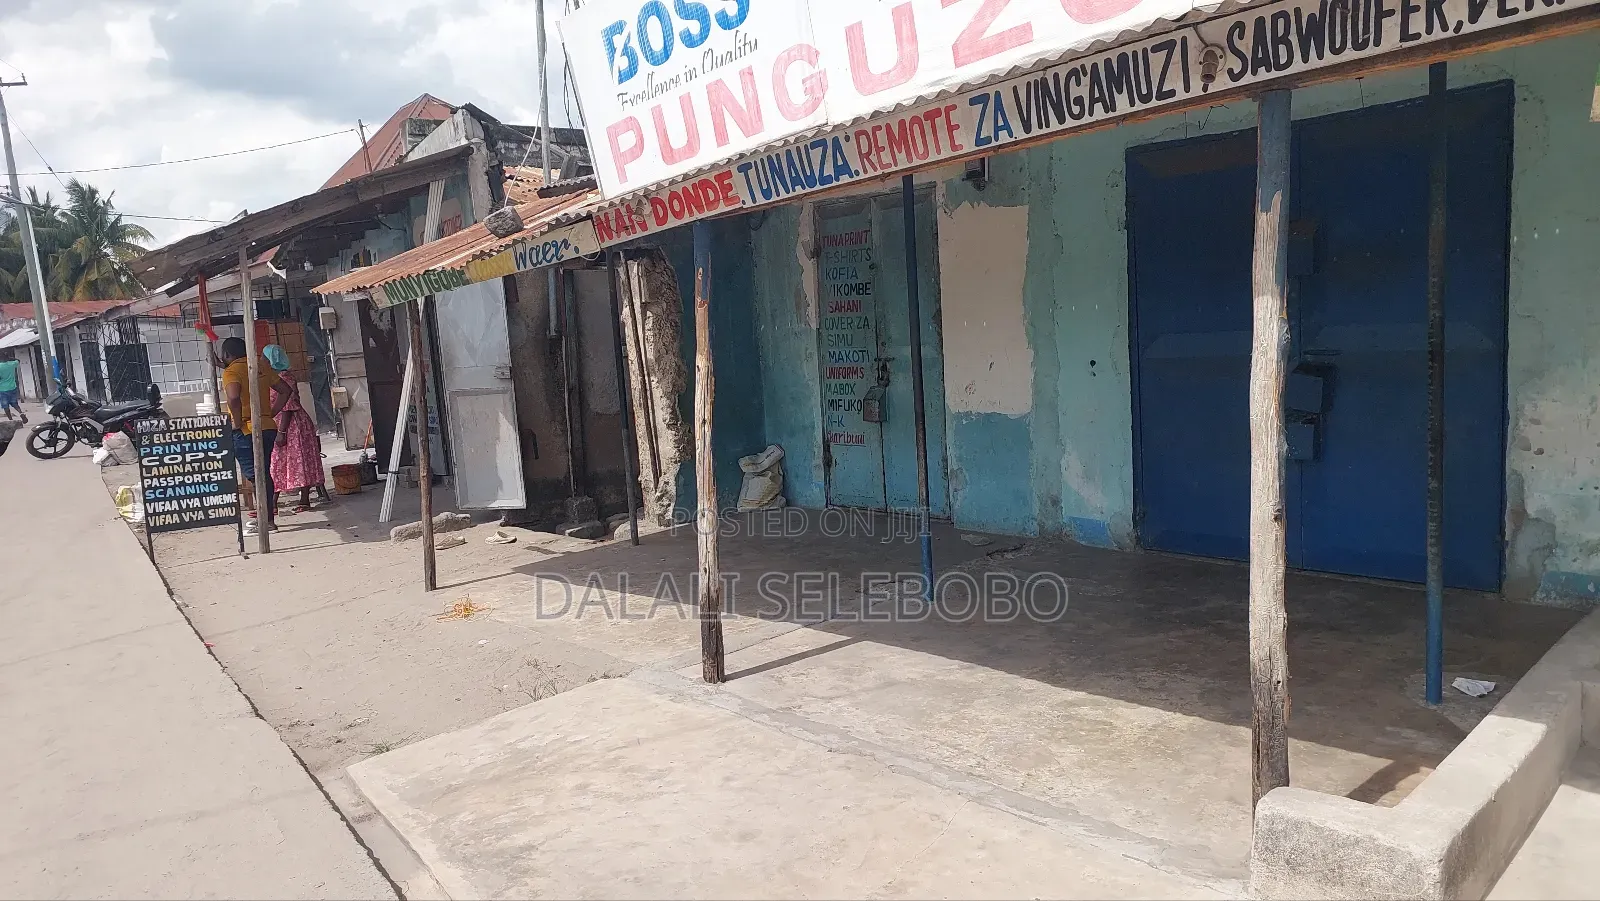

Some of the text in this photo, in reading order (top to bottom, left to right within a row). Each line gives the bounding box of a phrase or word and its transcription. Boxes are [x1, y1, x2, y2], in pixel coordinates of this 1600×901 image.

[684, 64, 698, 84] in
[606, 0, 1145, 185] PUNGUZ
[855, 105, 963, 175] REMOTE
[825, 248, 872, 264] T-SHIRTS
[825, 267, 859, 281] KOFIA
[828, 300, 862, 314] SAHANI
[825, 315, 870, 330] COVER ZA
[828, 333, 853, 348] SIMU
[828, 350, 870, 363] MAKOTI
[825, 366, 865, 380] UNIFORMS
[828, 398, 863, 414] MIFUKO
[169, 415, 228, 431] STATIONERY
[141, 429, 224, 446] & ELECTRONIC
[140, 441, 218, 457] PRINTING
[142, 450, 229, 466] COPY
[143, 460, 223, 477] LAMINATION
[145, 483, 219, 500] SCANNING
[146, 493, 238, 514] VIFAA VYA UMEME
[148, 506, 236, 527] VIFAA VYA SIMU
